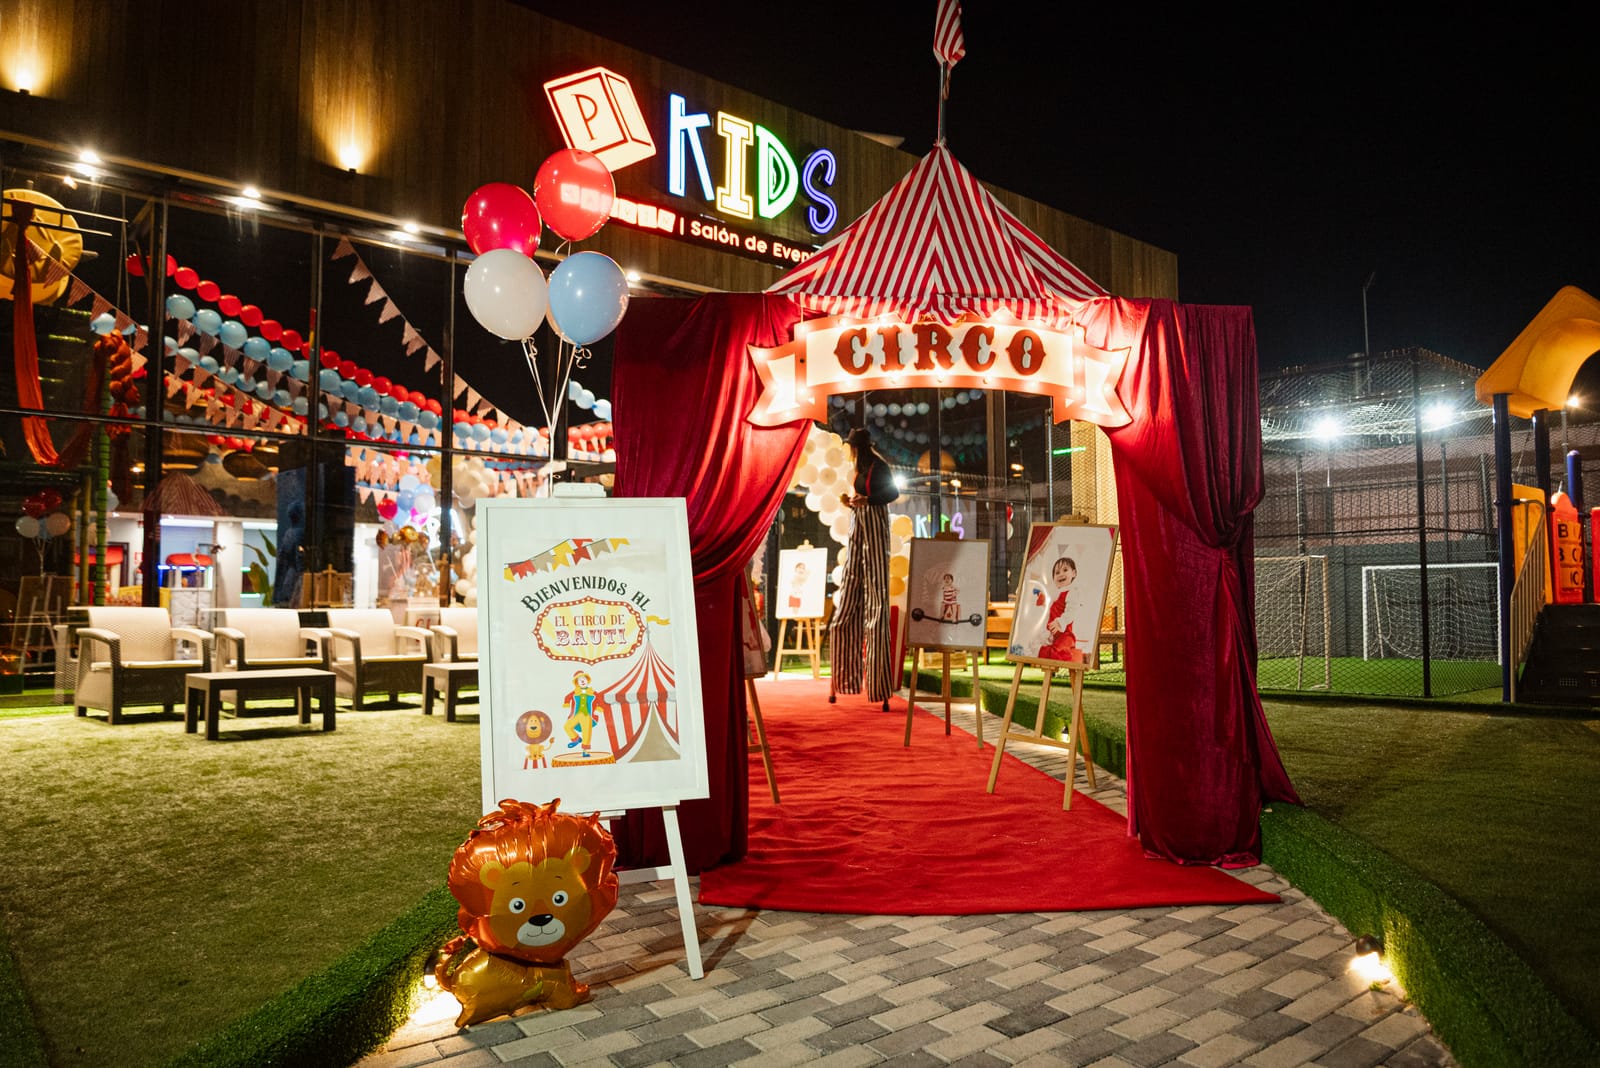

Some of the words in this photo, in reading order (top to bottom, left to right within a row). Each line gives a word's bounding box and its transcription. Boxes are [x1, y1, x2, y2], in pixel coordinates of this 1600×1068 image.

[571, 93, 598, 141] P
[668, 93, 838, 235] KIDS
[690, 220, 740, 247] Salón
[744, 235, 768, 254] de
[773, 242, 815, 263] Even
[833, 323, 1047, 376] CIRCO
[520, 575, 628, 614] BIENVENIDOS
[631, 590, 651, 612] AL
[554, 615, 570, 627] EL
[573, 614, 606, 626] CIRCO
[610, 614, 625, 625] DE
[555, 628, 628, 646] BAUTI
